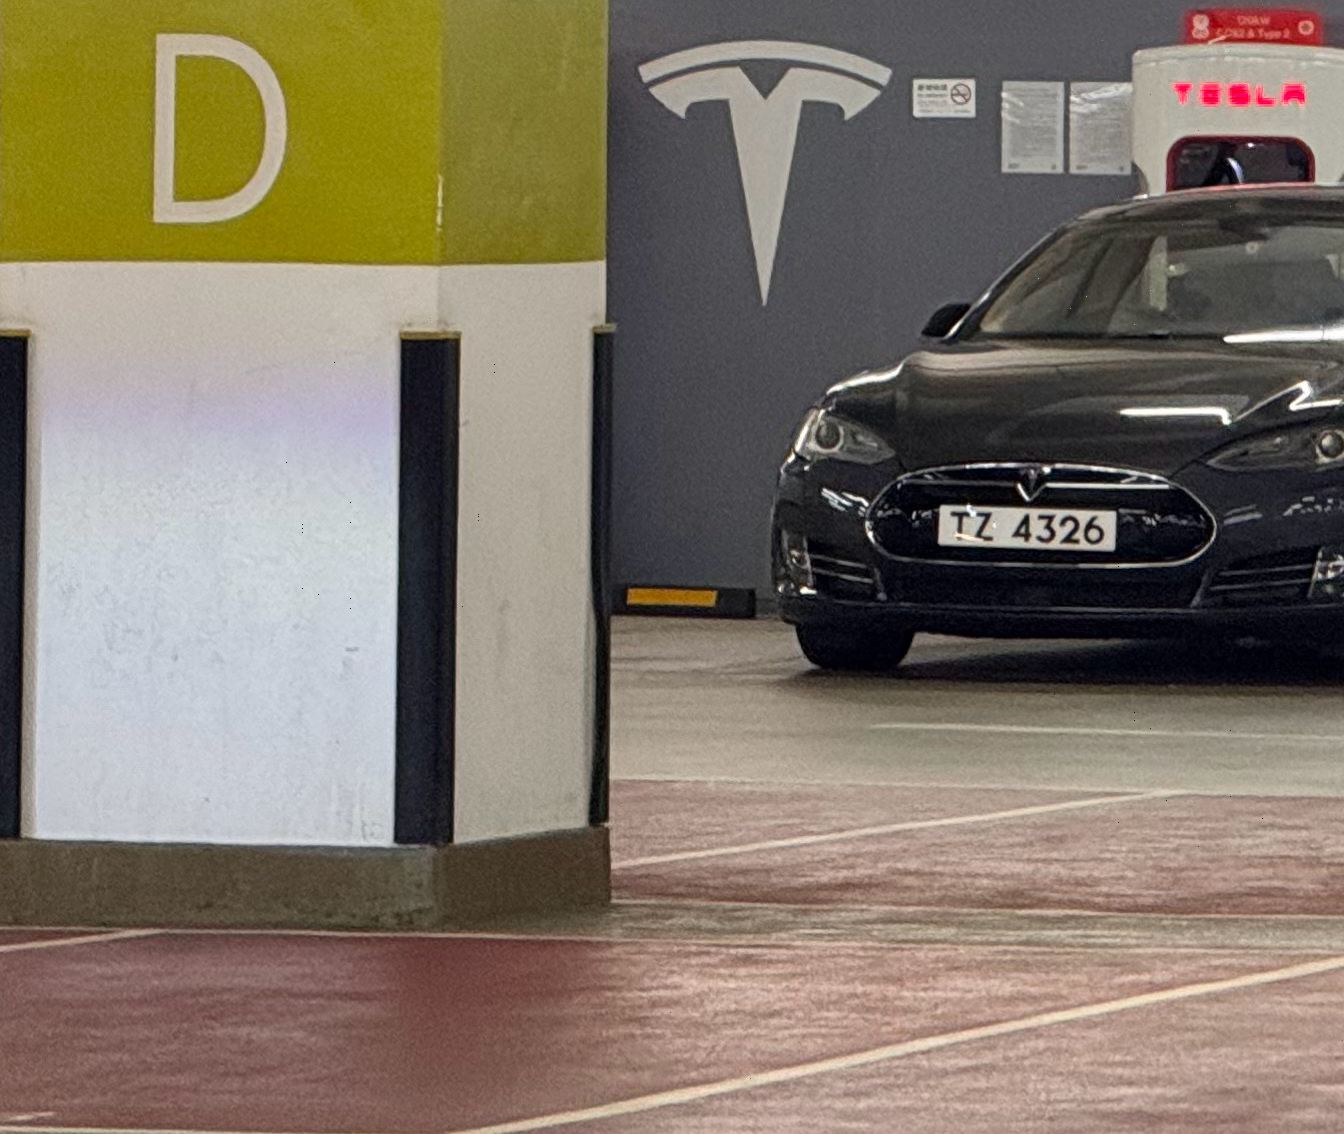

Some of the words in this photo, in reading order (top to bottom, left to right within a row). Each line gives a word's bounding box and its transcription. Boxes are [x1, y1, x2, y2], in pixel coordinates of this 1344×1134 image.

[1172, 82, 1306, 107] TESLA
[152, 33, 287, 225] D
[950, 511, 994, 542] TZ
[1012, 514, 1105, 545] 4326
